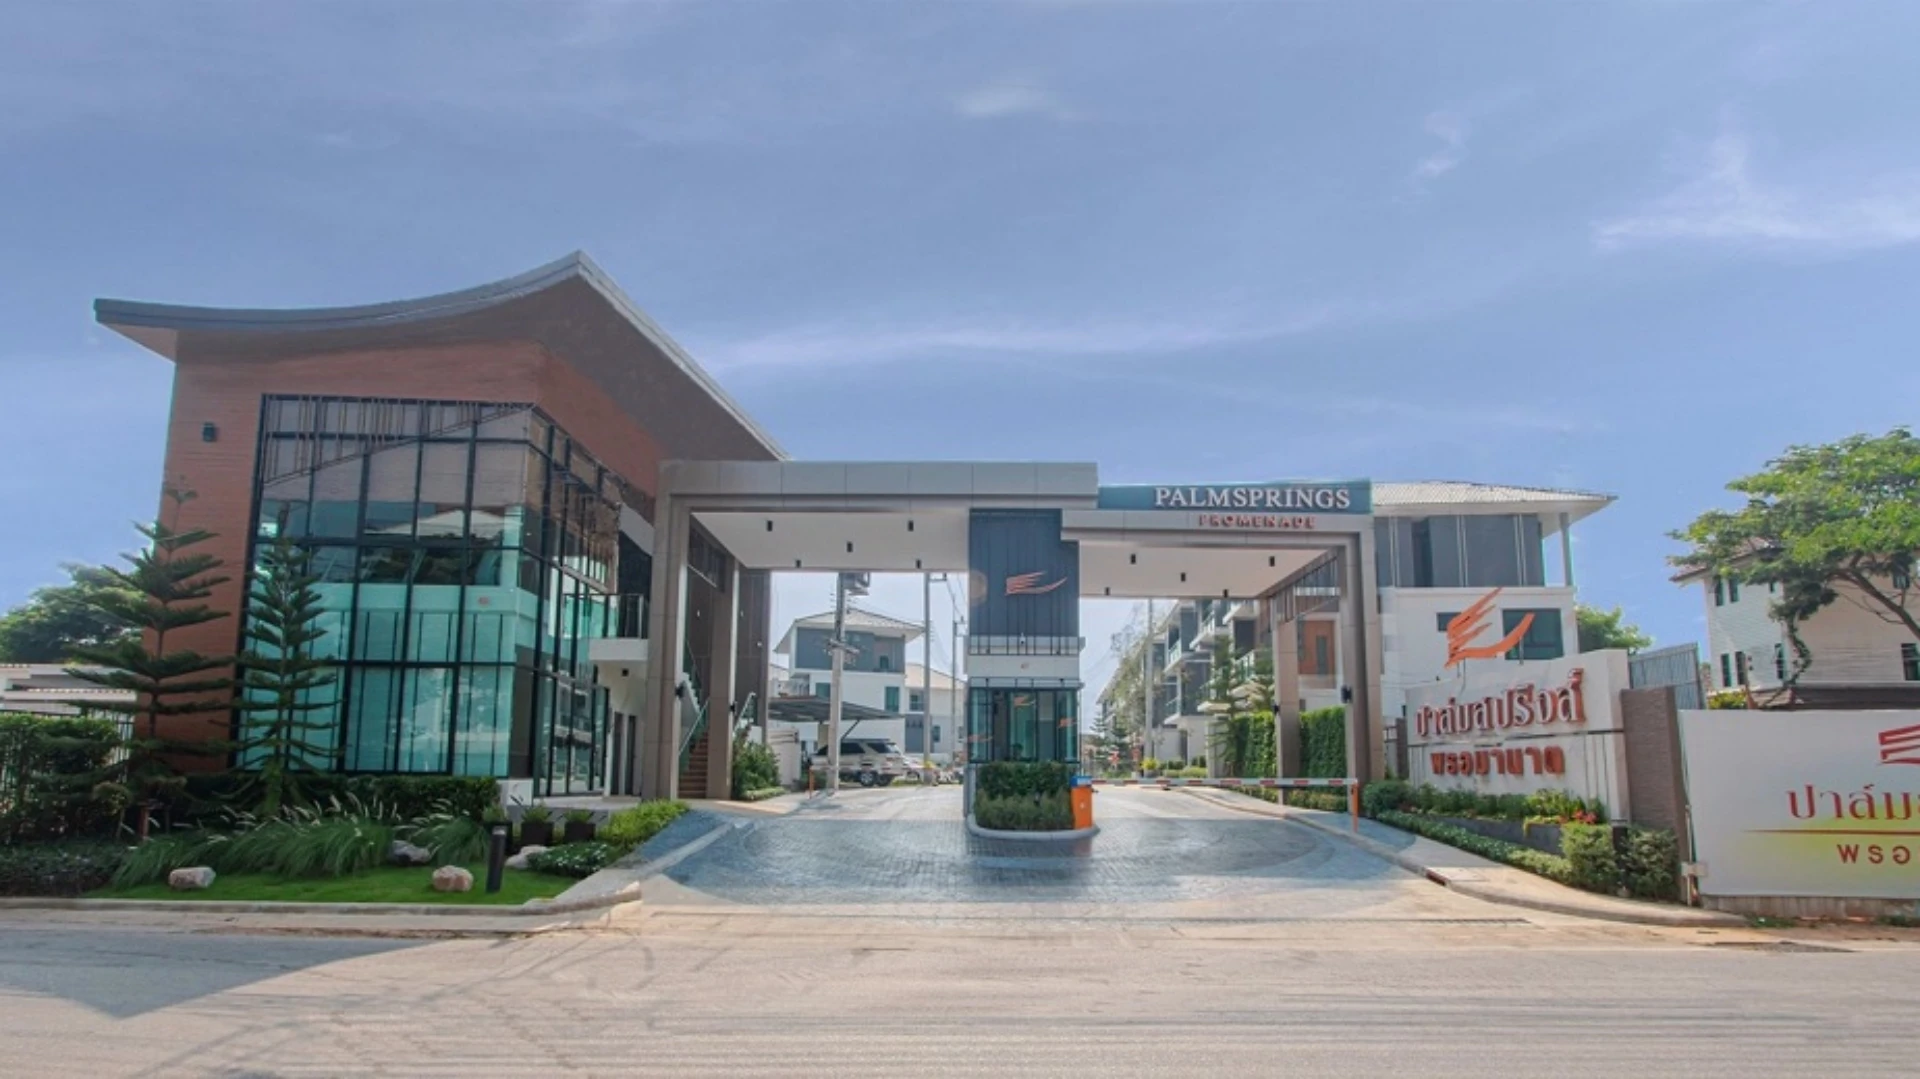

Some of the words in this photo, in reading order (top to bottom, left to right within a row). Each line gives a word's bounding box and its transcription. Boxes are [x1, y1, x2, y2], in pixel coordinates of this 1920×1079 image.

[1155, 486, 1350, 510] PALMSPRINGS
[1199, 514, 1315, 530] PROMENADE
[1786, 783, 1920, 820] ปาล์ม
[1836, 844, 1920, 865] พรอ
